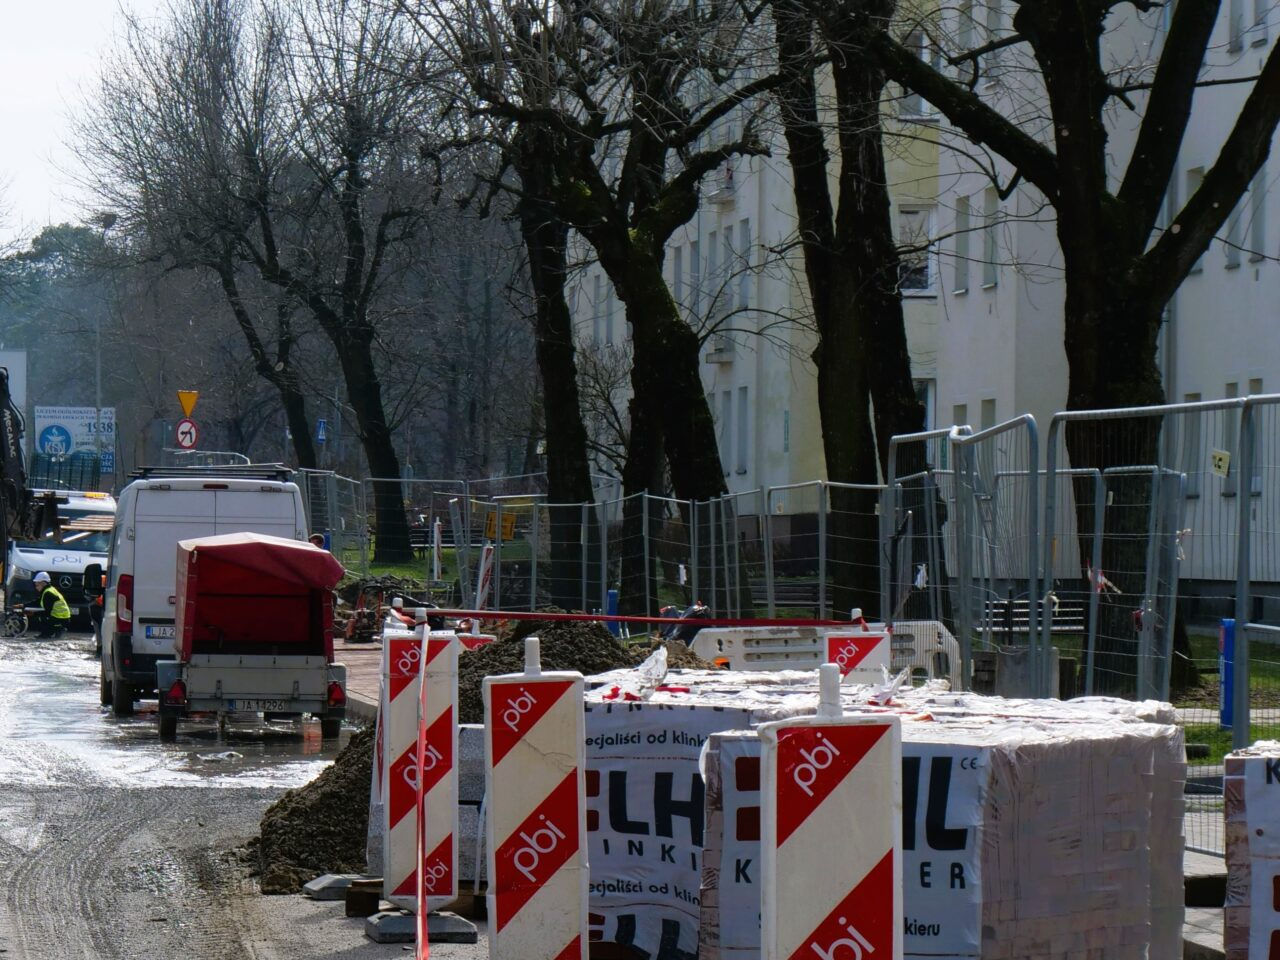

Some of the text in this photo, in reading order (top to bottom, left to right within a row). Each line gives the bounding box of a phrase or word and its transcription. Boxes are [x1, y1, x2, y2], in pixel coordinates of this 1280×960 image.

[52, 555, 82, 565] pbi
[151, 627, 167, 637] LJA
[398, 642, 422, 676] pbi
[836, 640, 859, 669] pbi
[234, 701, 251, 710] LJA
[503, 687, 537, 732] pbi
[585, 731, 709, 749] ecjaliści od klink
[403, 739, 443, 791] pbi
[794, 732, 840, 797] pbi
[609, 770, 705, 848] LH
[513, 814, 566, 883] pbi
[424, 858, 449, 892] pbi
[589, 879, 701, 906] ecjaliści od klin
[904, 917, 940, 937] kieru
